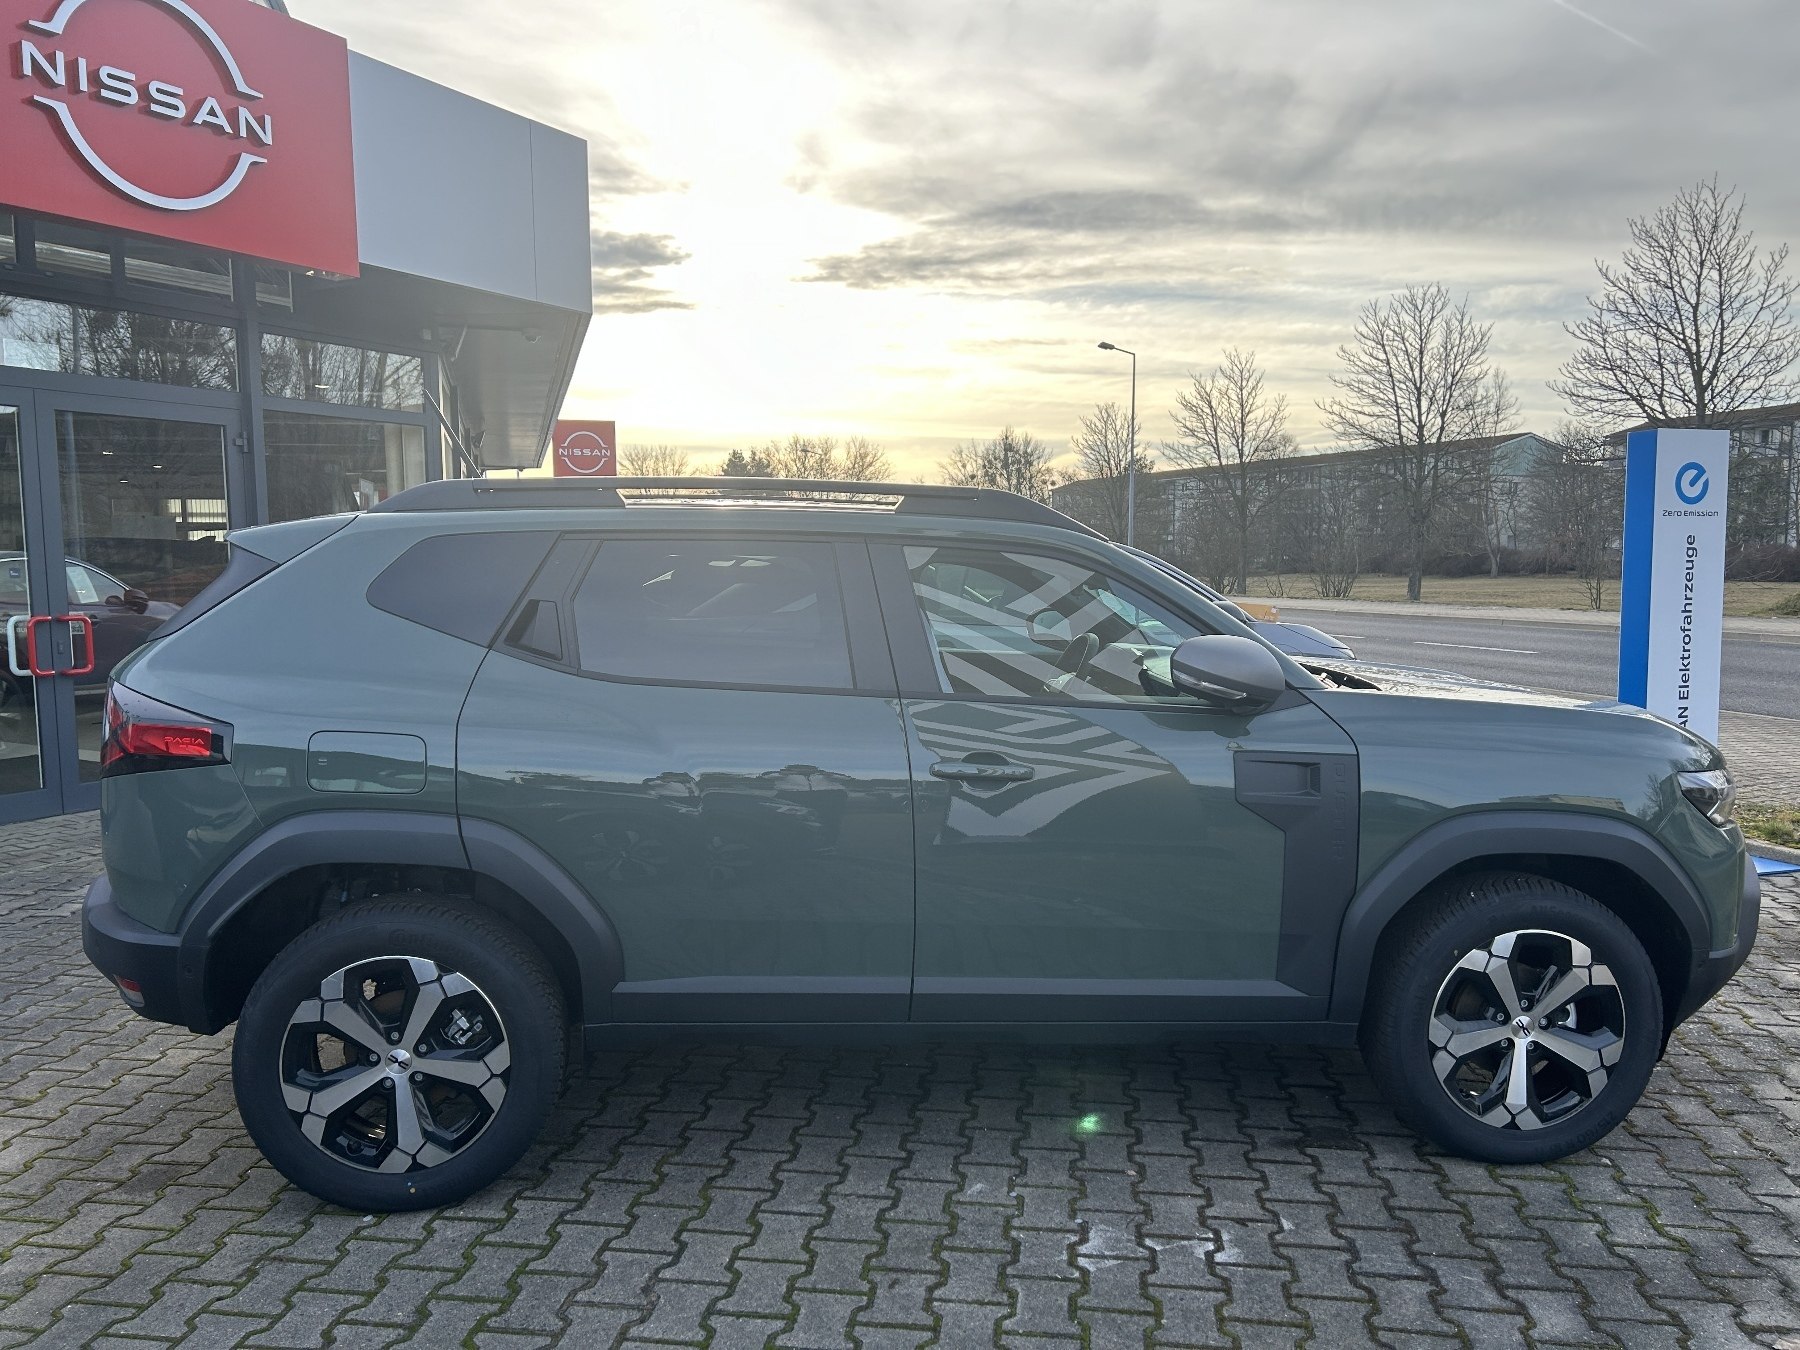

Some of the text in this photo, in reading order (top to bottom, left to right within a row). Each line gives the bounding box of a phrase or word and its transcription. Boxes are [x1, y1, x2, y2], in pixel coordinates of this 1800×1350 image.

[21, 40, 272, 145] NISSAN
[559, 448, 610, 456] NISSAN
[1662, 509, 1719, 517] Zero Emission
[1678, 534, 1698, 701] Elektrofahrzeuge
[164, 736, 205, 745] DACIA
